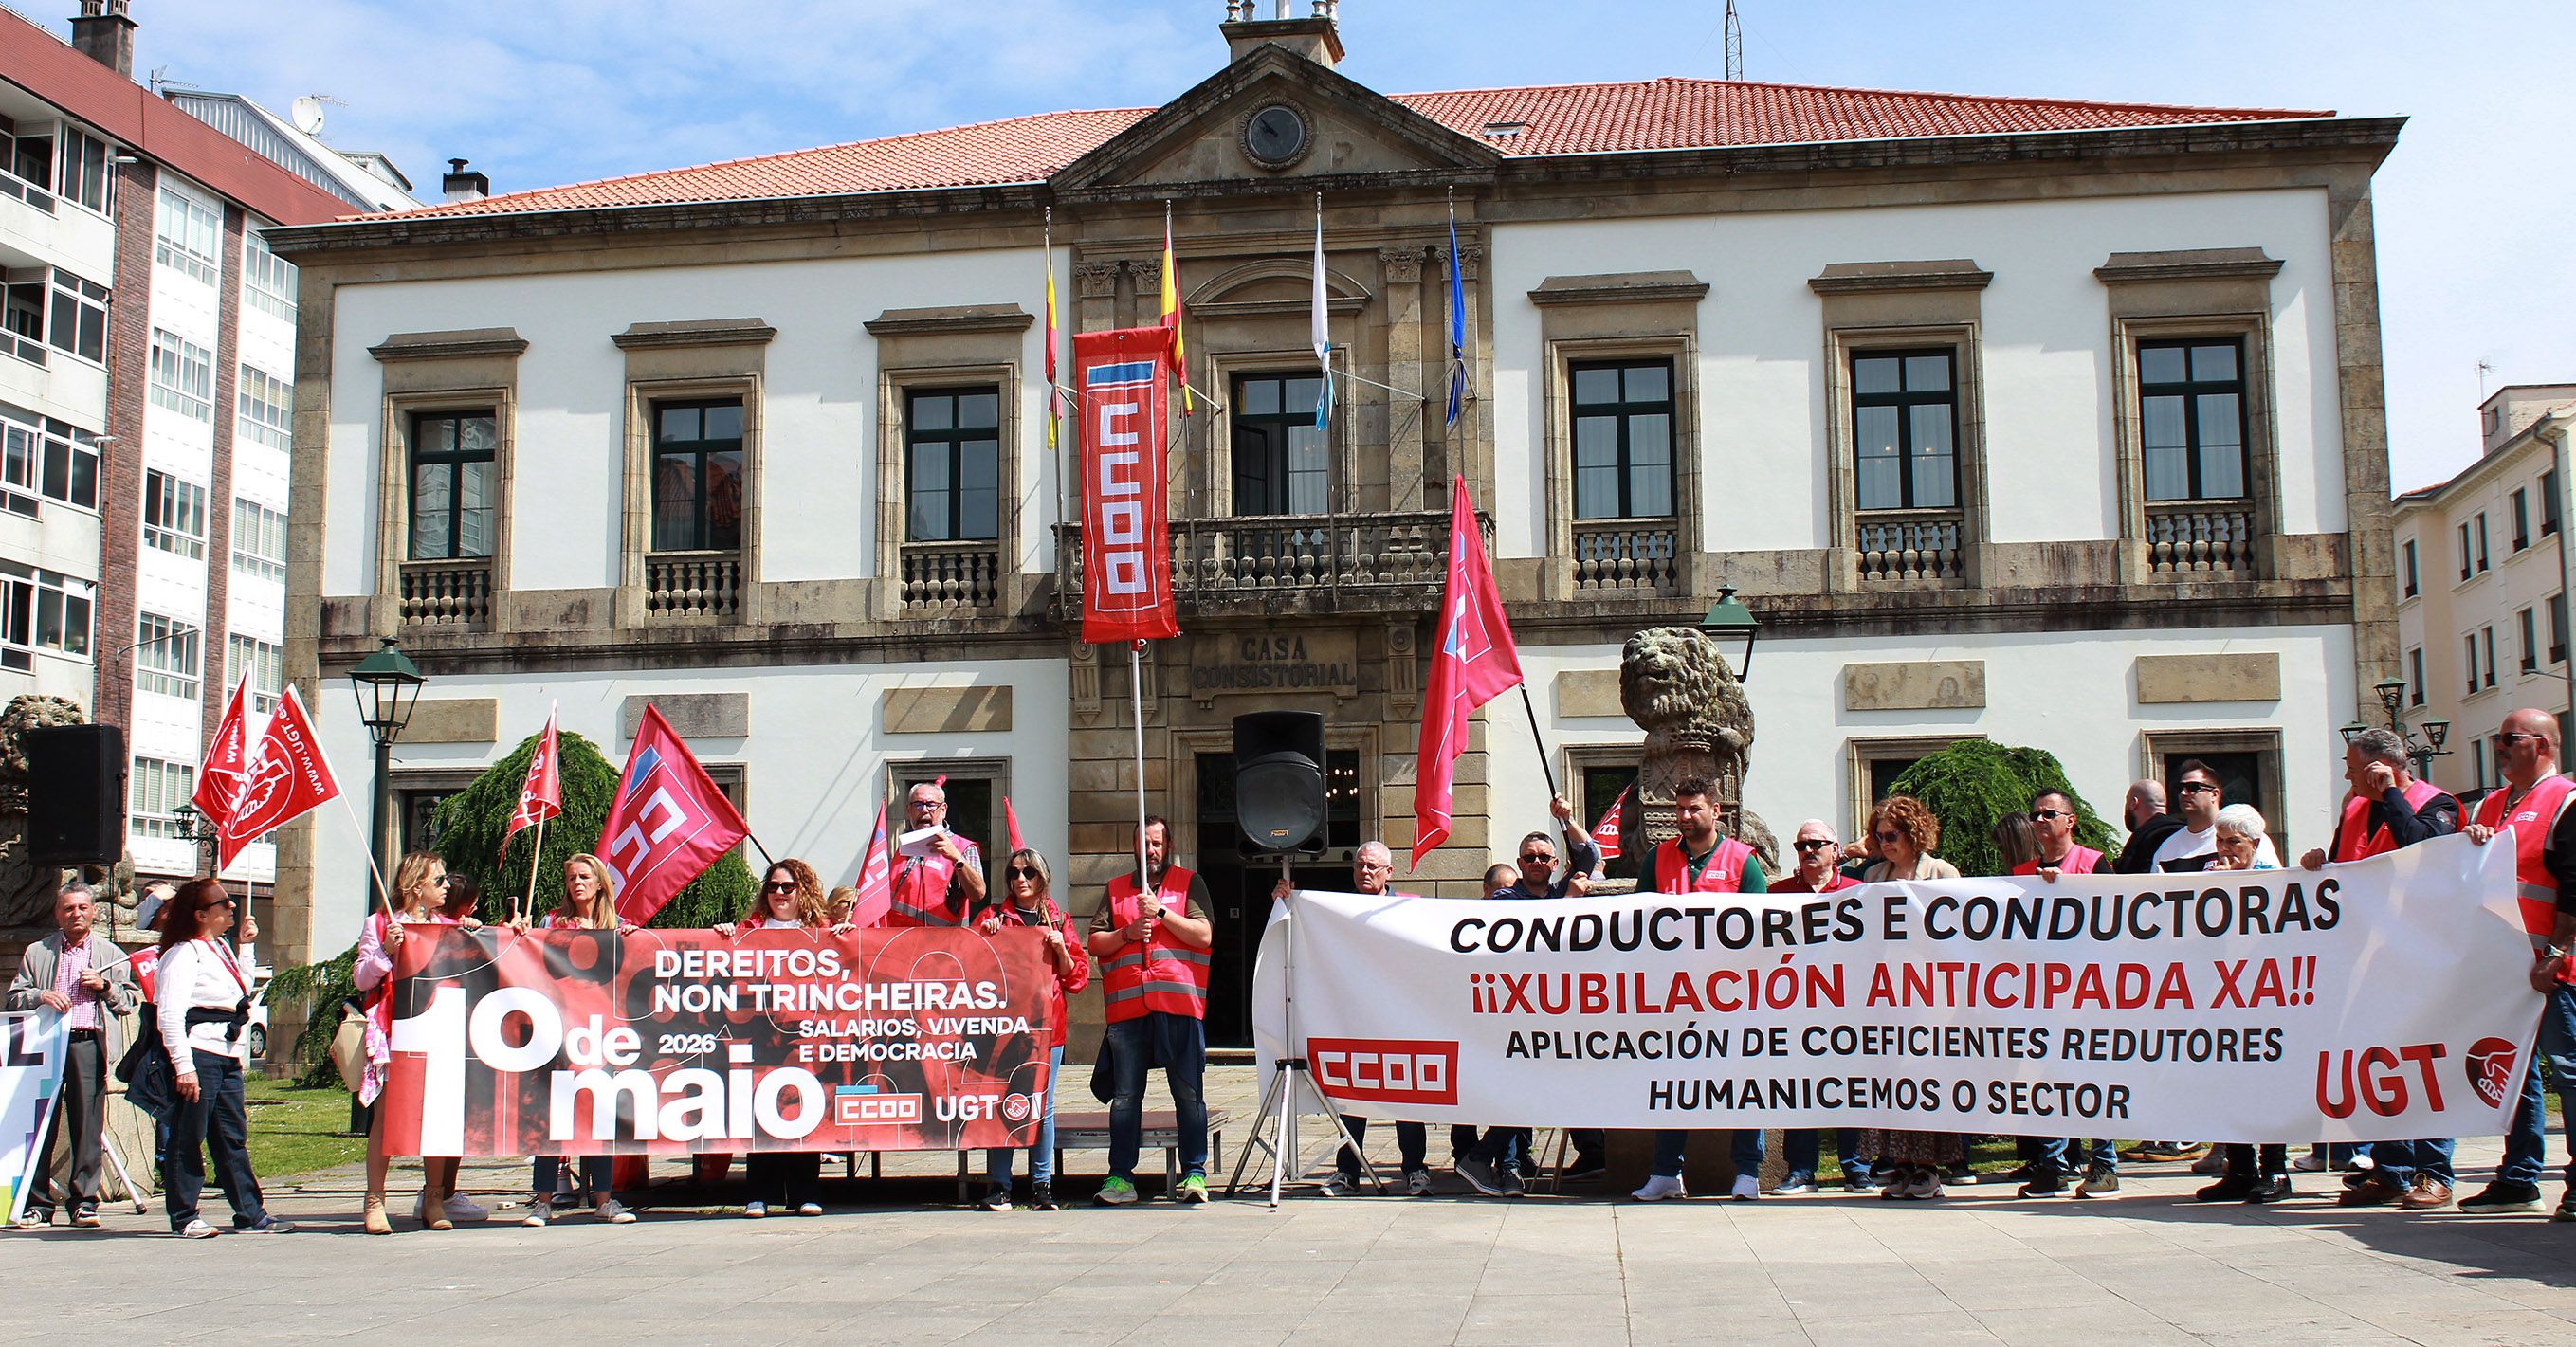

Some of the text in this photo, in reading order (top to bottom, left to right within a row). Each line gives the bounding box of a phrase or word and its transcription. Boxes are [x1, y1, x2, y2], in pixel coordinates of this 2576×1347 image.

[1099, 402, 1147, 594] CCOO
[1241, 636, 1306, 661] CASA
[1192, 663, 1357, 689] CONSISTORIAL
[1451, 879, 2340, 953] CONDUCTORES E CONDUCTORAS
[655, 948, 850, 981] DEREITOS,
[655, 980, 1008, 1013] NON TRINCHEIRAS.
[1471, 954, 2316, 1015] ¡¡XUBILACIÓN ANTICIPADA XA!!
[565, 1014, 642, 1066] de
[658, 1033, 717, 1055] 2026
[799, 1016, 1031, 1040] SALARIOS, VIVENDA
[1506, 1022, 2284, 1063] APLICACIÓN DE COEFICIENTES REDUTORES
[799, 1042, 977, 1063] E DEMOCRACIA
[1317, 1051, 1447, 1092] CCOO
[2316, 1044, 2446, 1119] UGT
[549, 1043, 827, 1142] maio
[842, 1100, 917, 1120] CCOO
[936, 1093, 1000, 1121] UGT
[1649, 1077, 2131, 1119] HUMANICEMOS O SECTOR
